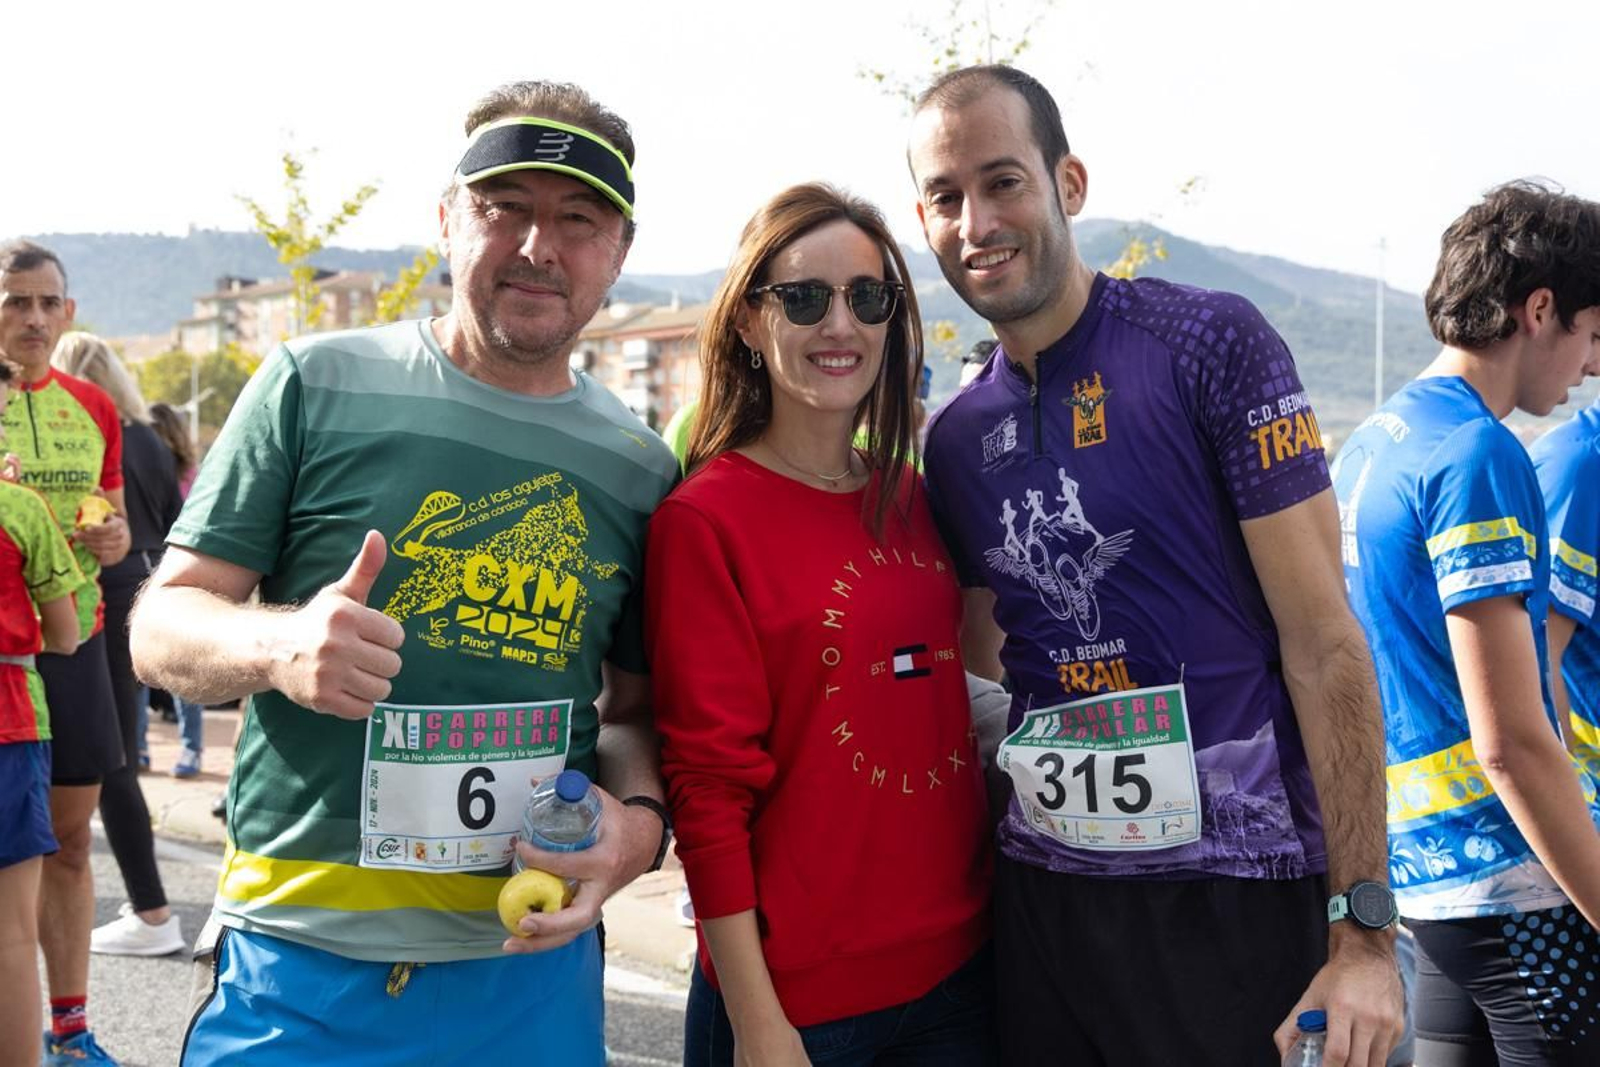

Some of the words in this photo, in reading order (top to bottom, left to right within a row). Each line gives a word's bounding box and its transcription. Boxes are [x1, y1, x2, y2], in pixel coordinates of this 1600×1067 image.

[1248, 404, 1277, 427] C.D.
[489, 489, 513, 504] los
[513, 471, 563, 495] agujetas
[477, 511, 490, 523] de
[463, 554, 579, 621] CXM
[455, 604, 568, 650] 2024
[822, 561, 862, 700] TOMMY
[934, 648, 955, 662] 1985
[1048, 648, 1075, 662] C.D.
[1075, 638, 1128, 661] BEDMAR
[871, 661, 886, 676] EST.
[1057, 658, 1139, 693] TRAIL
[381, 711, 421, 750] XI
[426, 708, 560, 730] CARRERA
[425, 725, 558, 750] POPULAR
[1122, 738, 1131, 747] la
[1132, 733, 1170, 747] igualdad
[384, 752, 399, 761] por
[402, 752, 410, 760] la
[411, 753, 424, 762] No
[427, 752, 466, 761] violencia
[468, 751, 479, 760] de
[482, 749, 509, 762] género
[511, 751, 516, 760] y
[518, 749, 525, 758] la
[527, 746, 555, 758] igualdad
[1034, 752, 1152, 814] 315
[457, 766, 496, 830] 6
